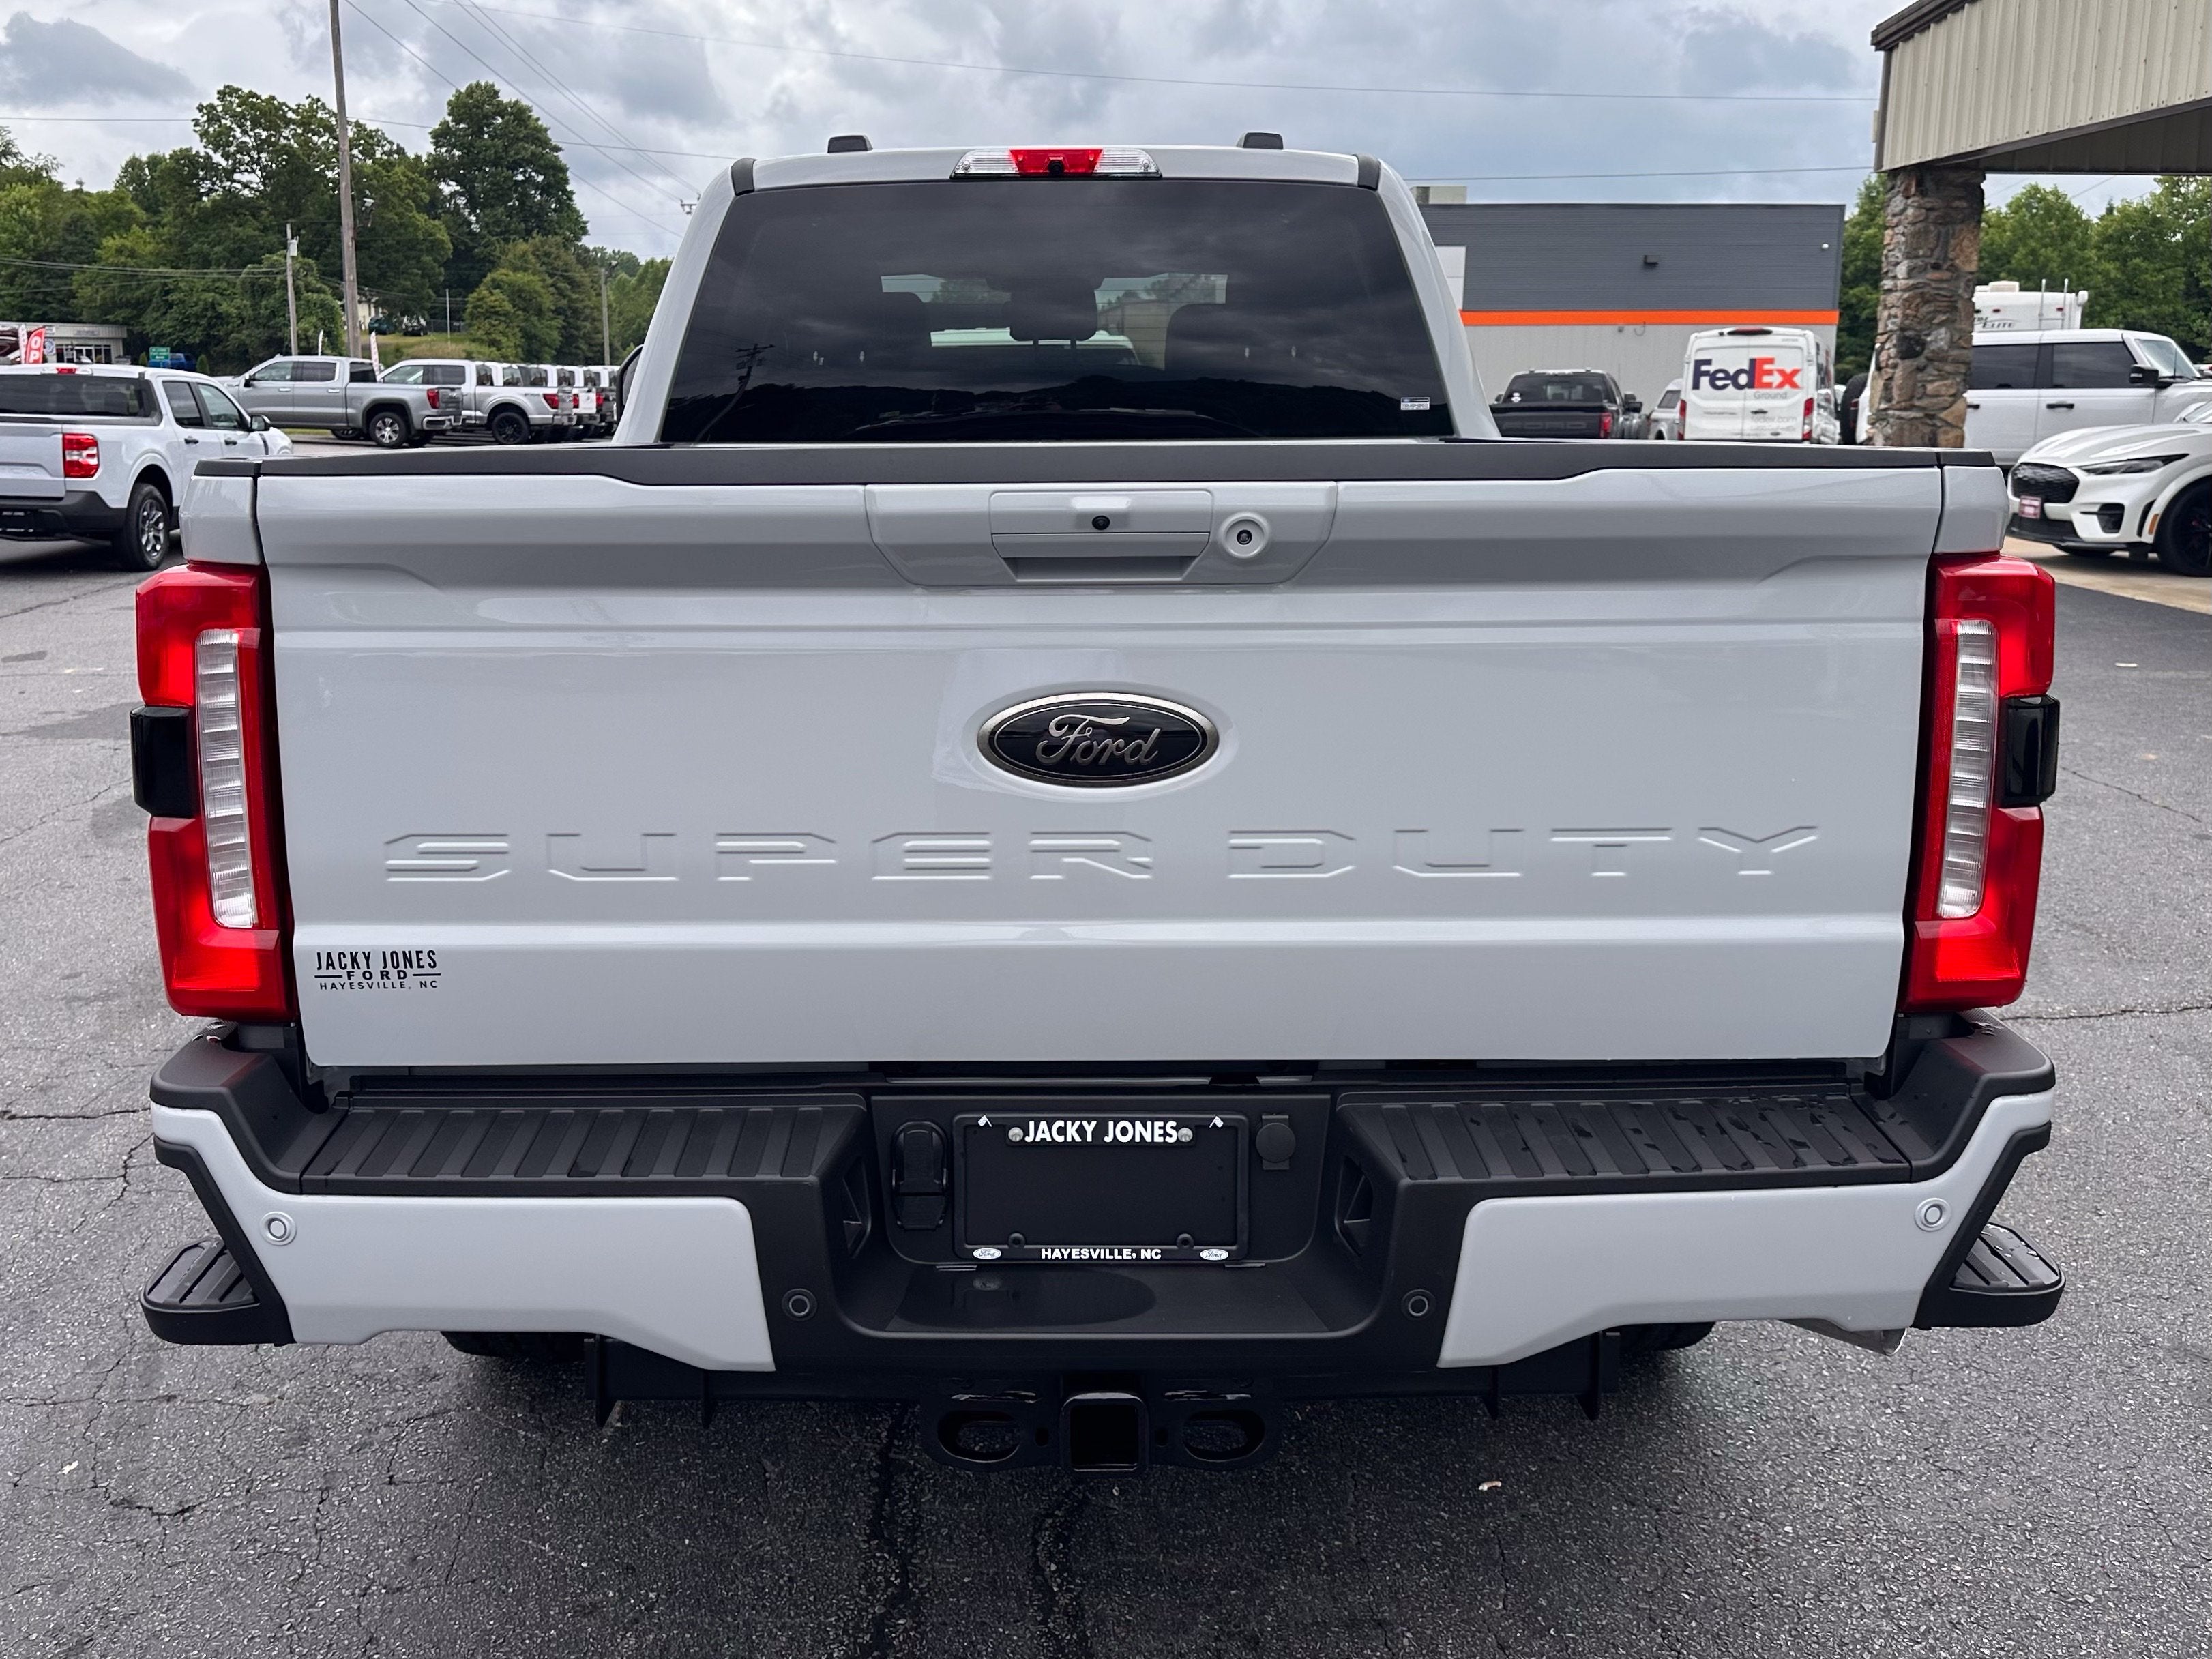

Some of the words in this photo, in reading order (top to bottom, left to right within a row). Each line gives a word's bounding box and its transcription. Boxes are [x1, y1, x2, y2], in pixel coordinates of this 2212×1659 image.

[1692, 357, 1803, 390] FedEx
[1503, 421, 1587, 430] FORD
[1035, 714, 1161, 765] Ford
[384, 830, 1152, 882] SUPER
[1228, 826, 1818, 879] DUTY
[316, 951, 371, 971] JACKY
[382, 950, 437, 969] JONES
[346, 969, 407, 981] FORD
[419, 980, 438, 988] NC
[1024, 1120, 1097, 1143] JACKY
[1104, 1120, 1177, 1143] JONES
[1041, 1248, 1136, 1259] HAYESVILLE,
[1140, 1248, 1162, 1259] NC
